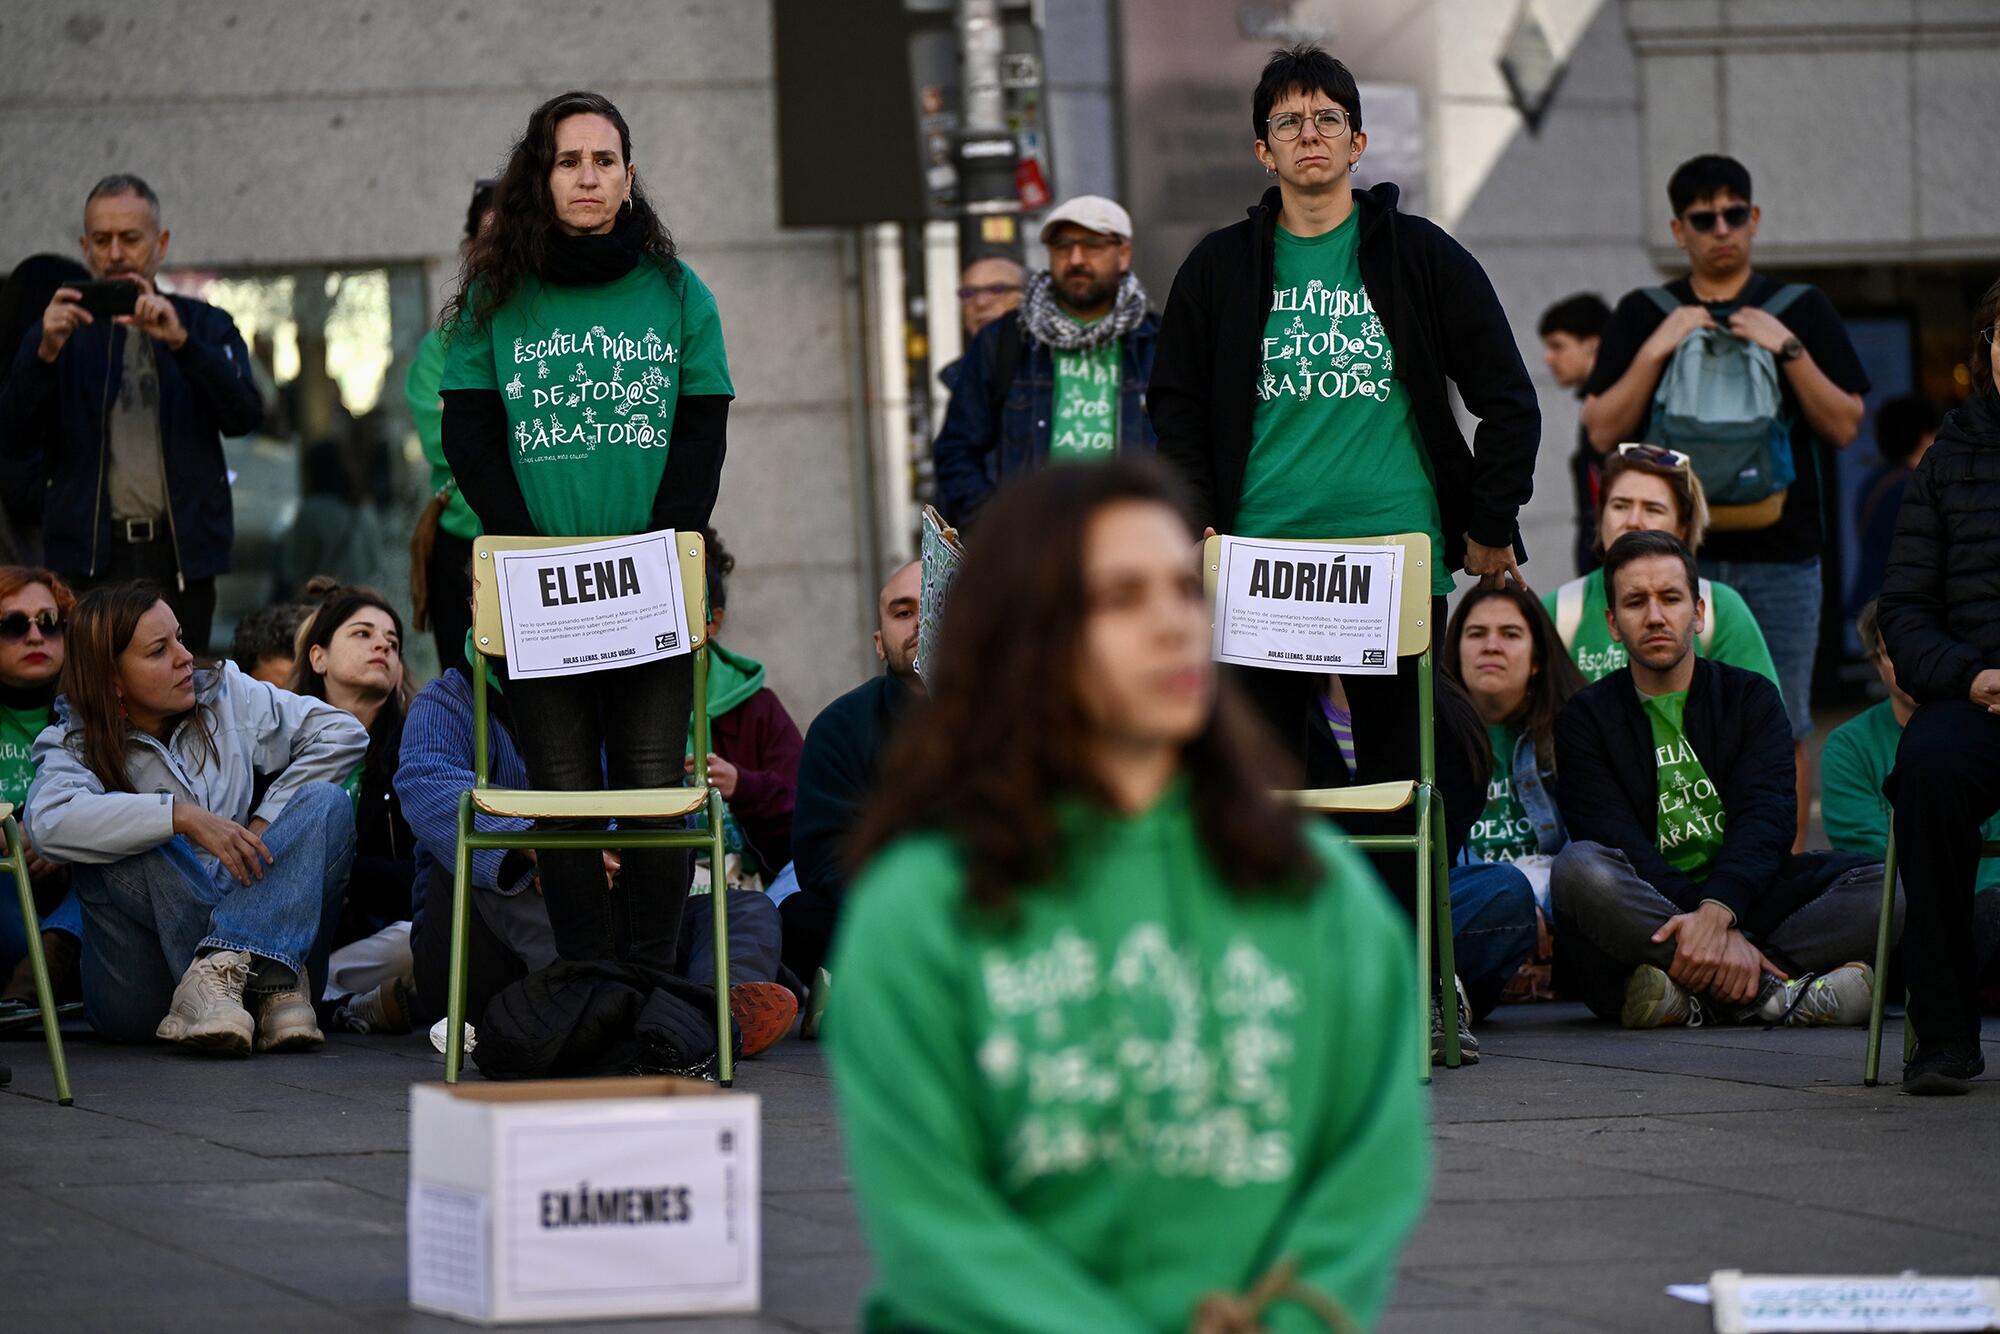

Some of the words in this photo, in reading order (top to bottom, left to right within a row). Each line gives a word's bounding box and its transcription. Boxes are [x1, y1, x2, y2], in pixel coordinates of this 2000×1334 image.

[514, 332, 594, 364] ESCUELA
[602, 332, 678, 363] PÚBLICA:
[1262, 337, 1282, 360] E
[1290, 332, 1383, 359] TOD@S
[532, 385, 564, 408] DE
[576, 381, 659, 406] TOD@S
[1299, 371, 1391, 402] TOD@S
[520, 424, 585, 453] PARA
[592, 424, 667, 449] TOD@S
[538, 557, 641, 607] ELENA
[1249, 554, 1371, 604] ADRIÁN
[563, 656, 579, 664] AULAS
[600, 652, 617, 660] SILLAS
[618, 648, 636, 657] VACÍAS
[1268, 650, 1284, 658] AULAS
[1305, 654, 1322, 662] SILLAS
[1323, 654, 1341, 662] VACÍAS
[1656, 740, 1690, 767] ELA
[541, 1181, 691, 1229] EXÁMENES
